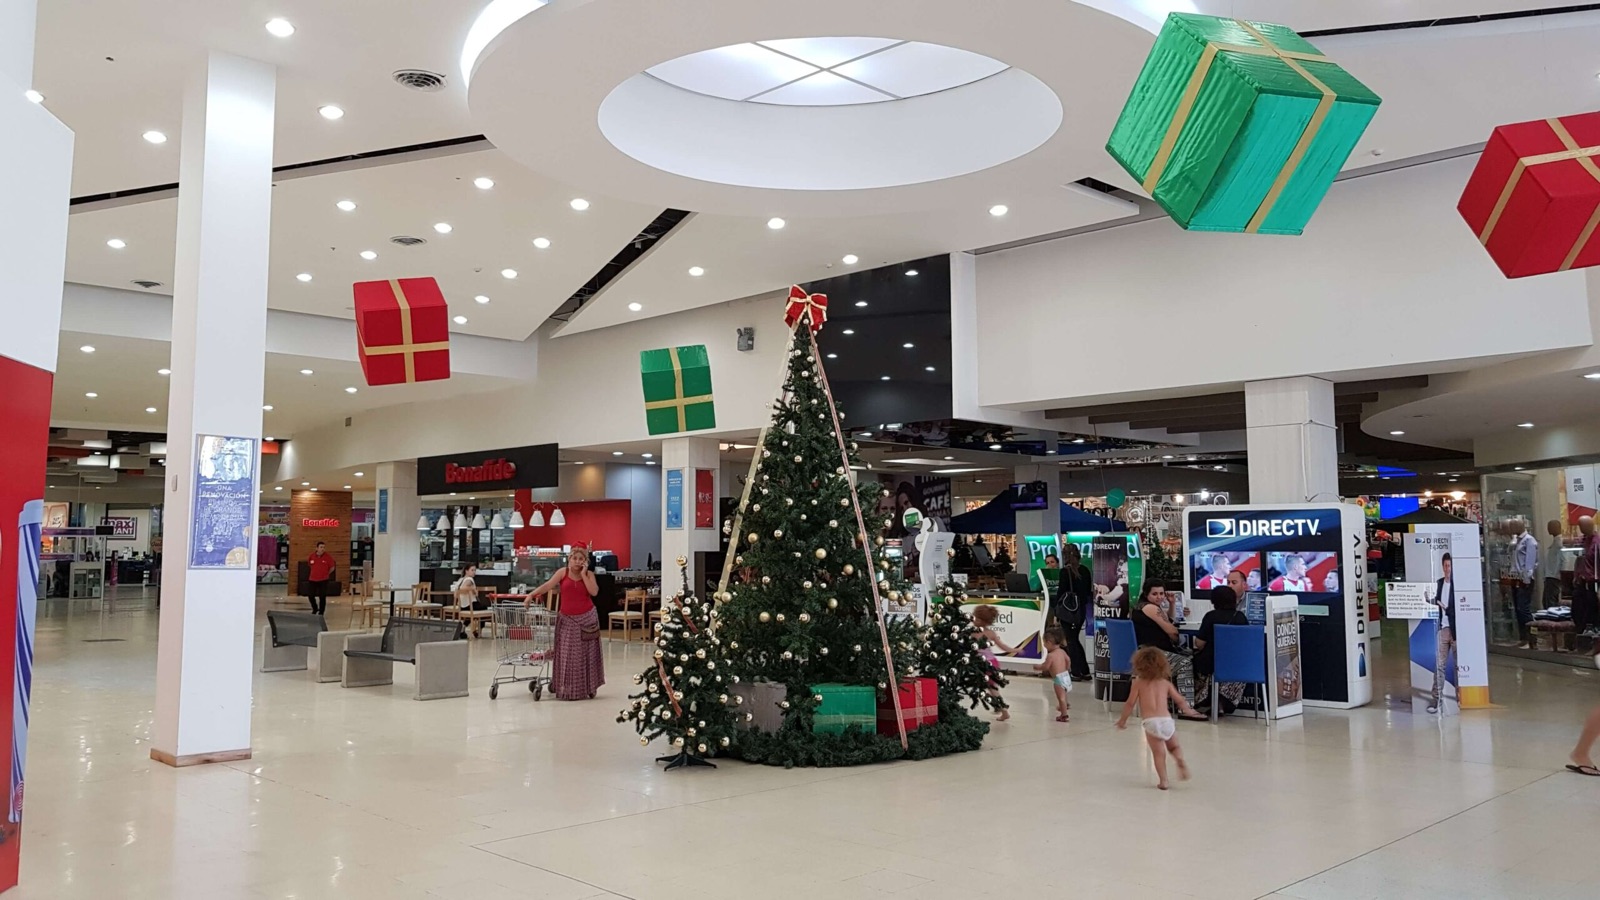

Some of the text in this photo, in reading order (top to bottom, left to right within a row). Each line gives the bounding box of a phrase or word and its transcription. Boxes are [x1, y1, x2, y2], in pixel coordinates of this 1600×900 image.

[445, 457, 517, 484] Bonafide
[302, 518, 340, 528] Bonafide
[1239, 519, 1320, 537] DIRECTV
[1353, 533, 1365, 634] DIRECTV
[1276, 621, 1296, 637] DONDE
[1276, 634, 1296, 648] QUIERAS
